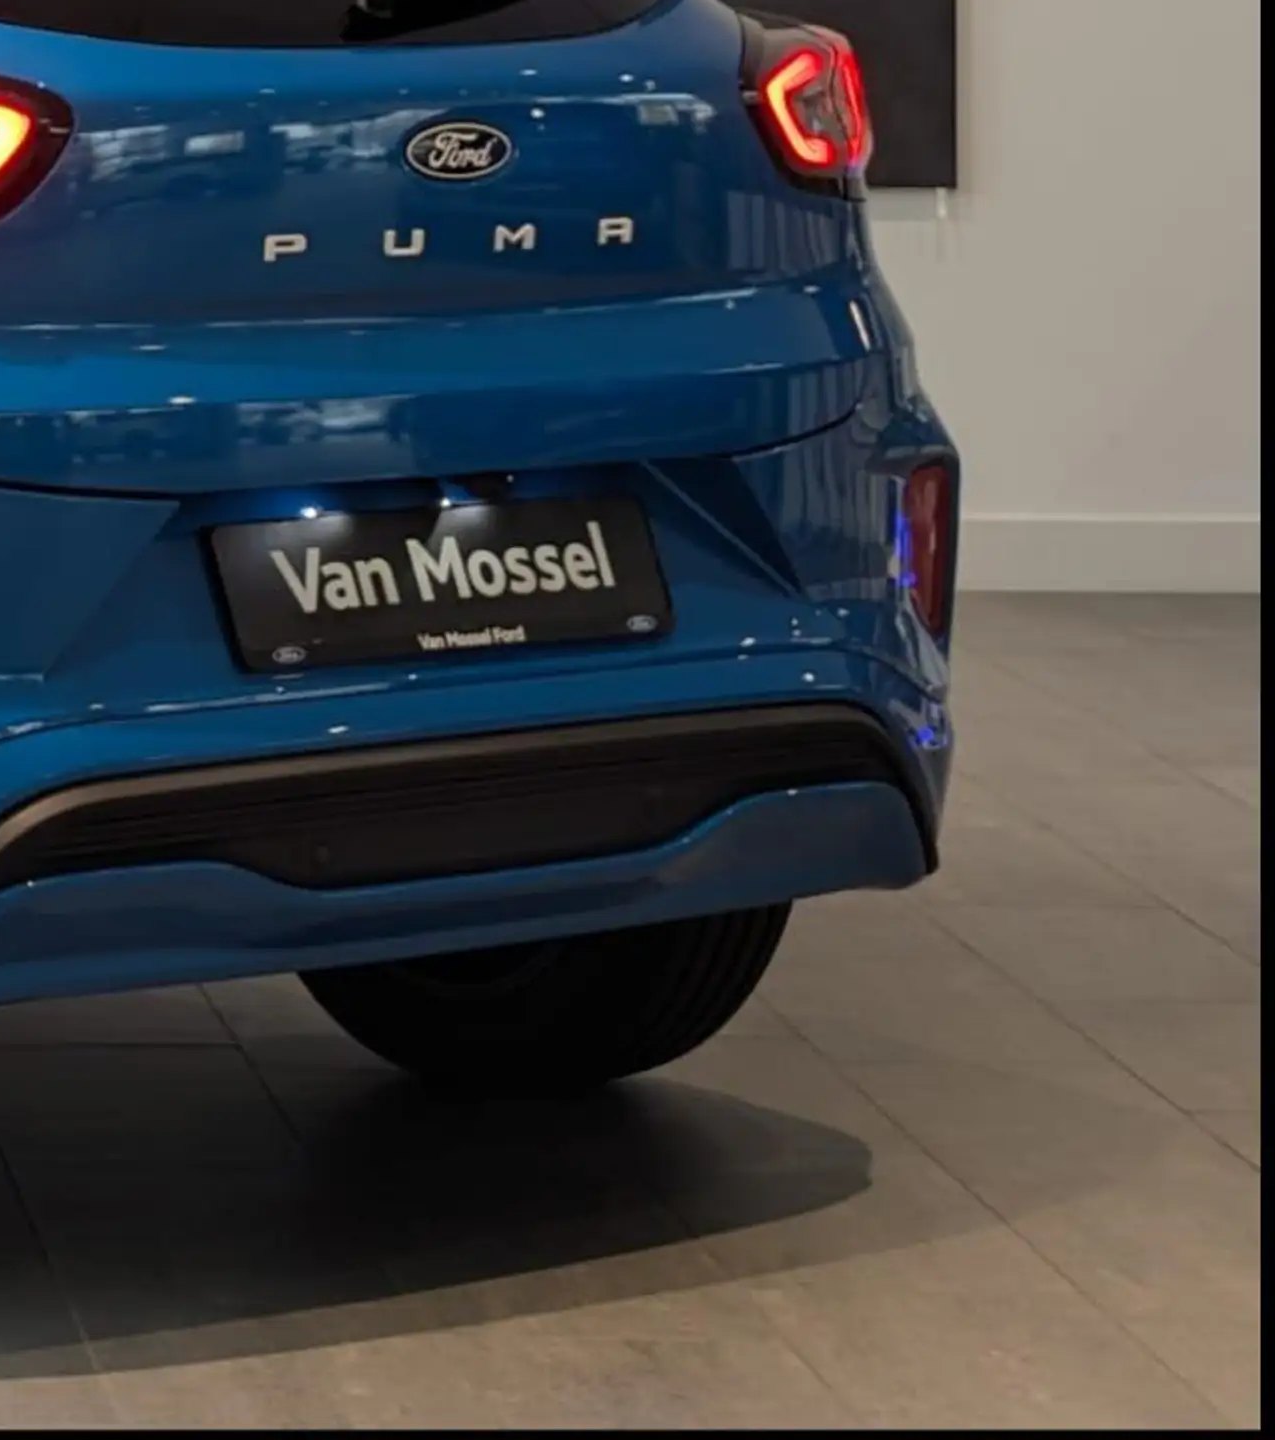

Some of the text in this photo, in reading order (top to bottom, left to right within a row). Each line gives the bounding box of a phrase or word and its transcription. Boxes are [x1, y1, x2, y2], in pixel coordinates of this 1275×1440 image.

[427, 130, 499, 169] Ford
[271, 521, 616, 613] Van Mossel
[416, 632, 446, 651] Van
[492, 624, 527, 645] Ford
